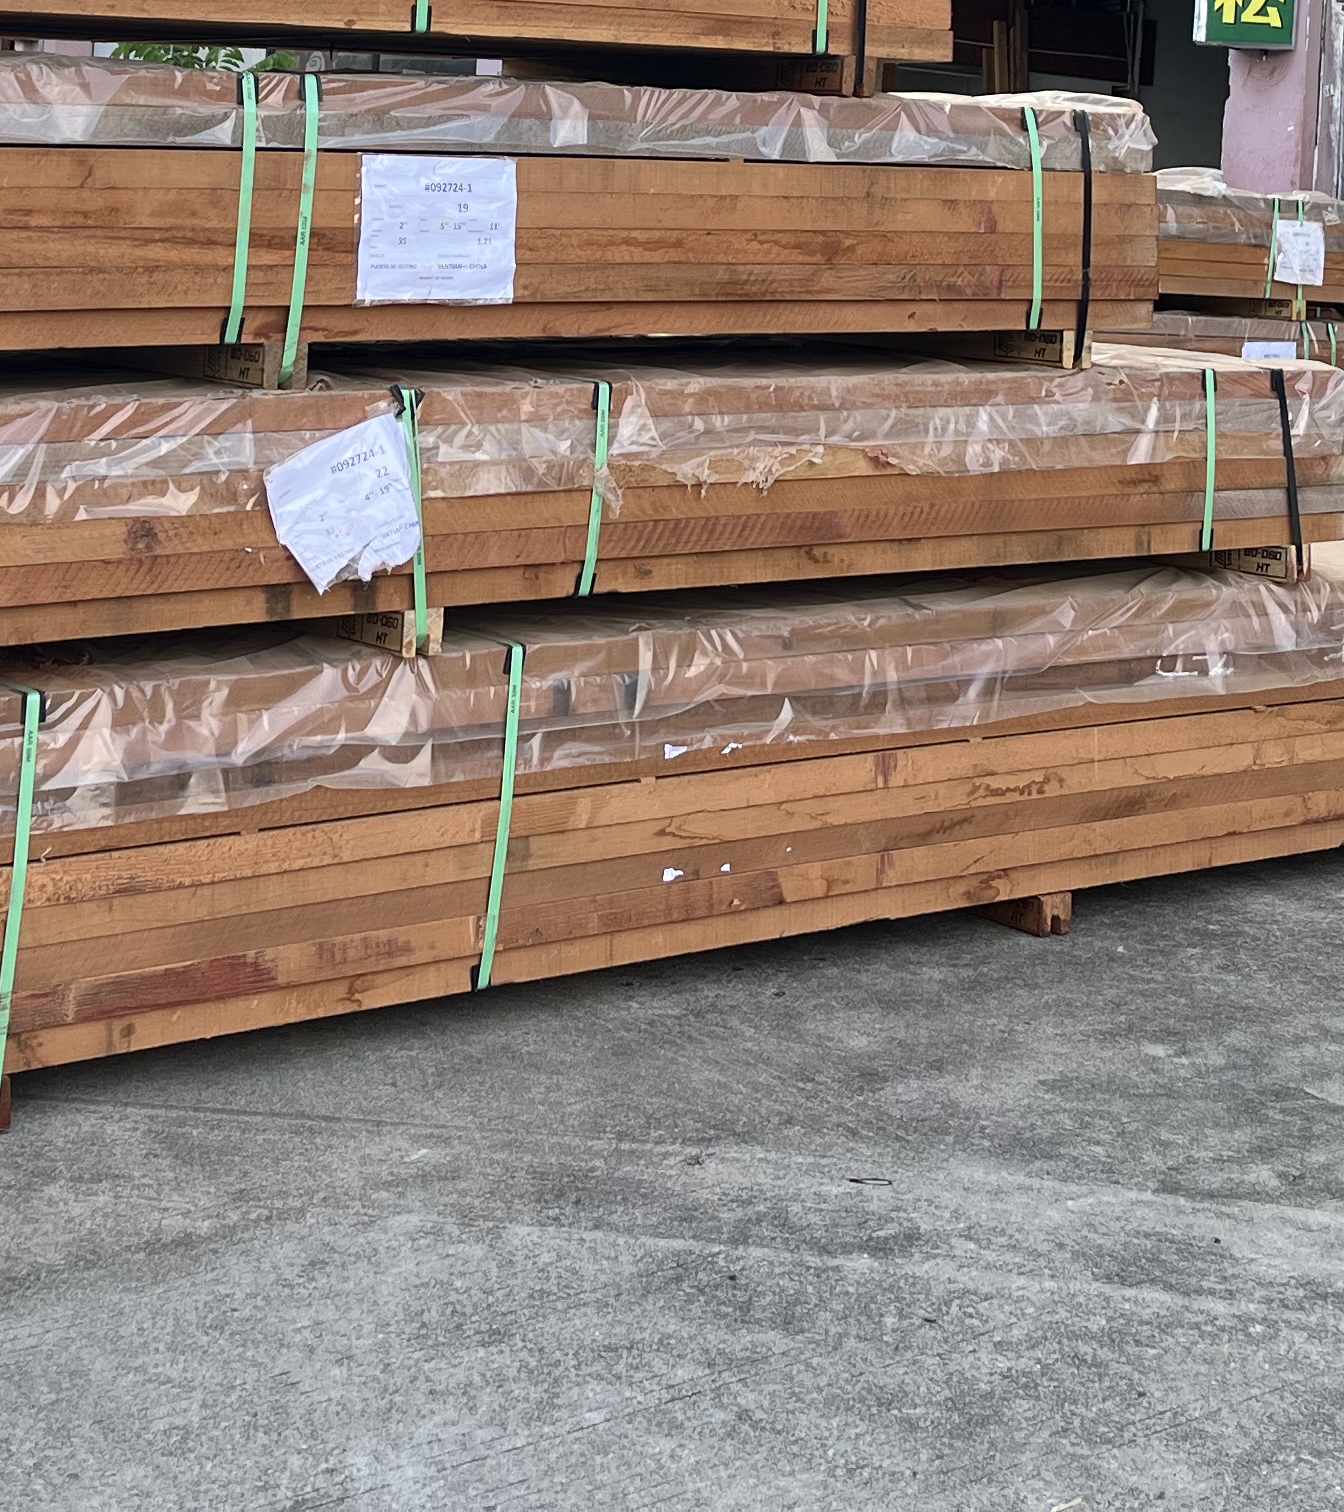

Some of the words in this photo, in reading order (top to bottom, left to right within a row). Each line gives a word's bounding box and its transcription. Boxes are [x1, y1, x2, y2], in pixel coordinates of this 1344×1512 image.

[457, 203, 469, 213] 19
[330, 444, 386, 475] #092724-1
[374, 466, 391, 479] 22
[1256, 562, 1270, 573] HT
[375, 631, 389, 645] HT
